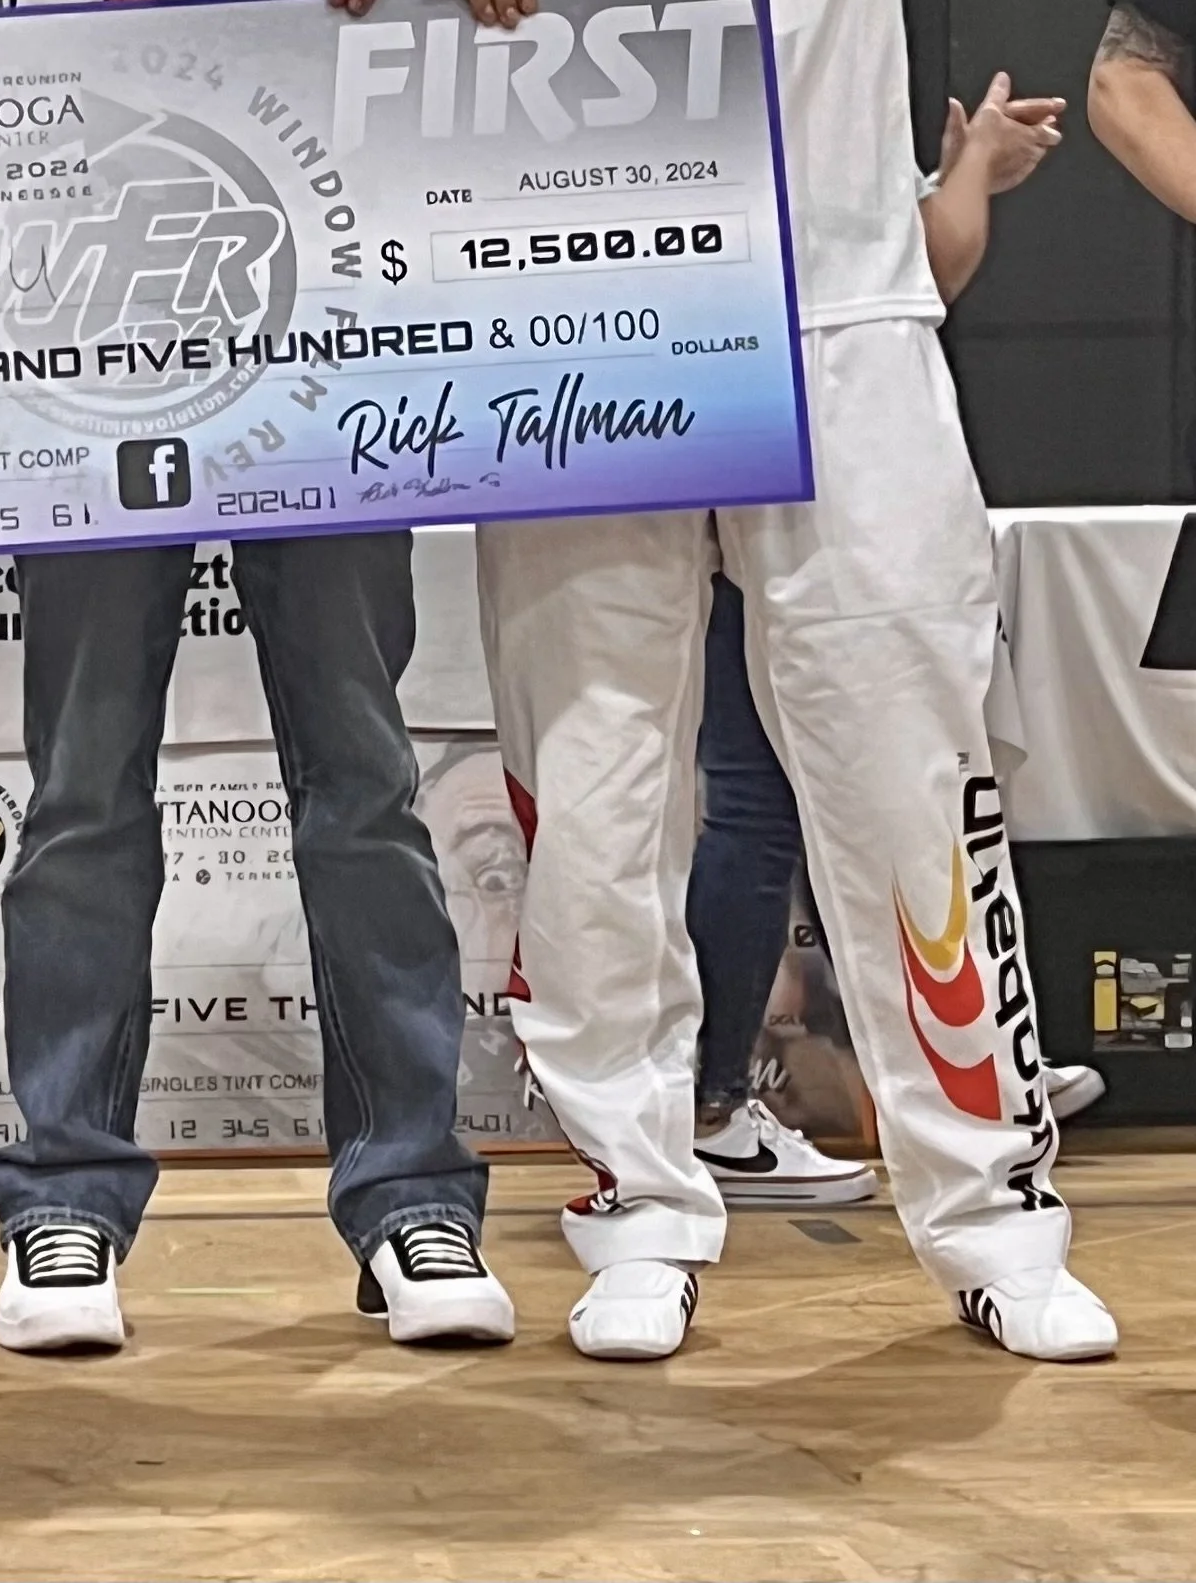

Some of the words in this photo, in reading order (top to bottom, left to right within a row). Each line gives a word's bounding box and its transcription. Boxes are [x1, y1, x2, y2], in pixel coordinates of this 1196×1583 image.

[3, 71, 83, 87] REUNION
[6, 158, 90, 181] 2024
[247, 86, 363, 279] WINDOW
[425, 188, 473, 206] DATE
[519, 165, 619, 192] AUGUST
[624, 163, 660, 186] 30,
[664, 160, 719, 182] 2024
[380, 238, 409, 286] $
[460, 223, 723, 272] 12,500.00
[98, 337, 212, 377] FIVE
[228, 319, 473, 368] HUNDRED
[488, 317, 515, 350] &
[528, 307, 662, 349] 00/100
[670, 334, 760, 357] DOLLARS
[337, 381, 466, 478] Rick
[487, 372, 697, 472] Tallman
[17, 445, 91, 470] COMP
[217, 486, 338, 517] 202401
[223, 1074, 263, 1091] TINT
[222, 1117, 270, 1139] 345
